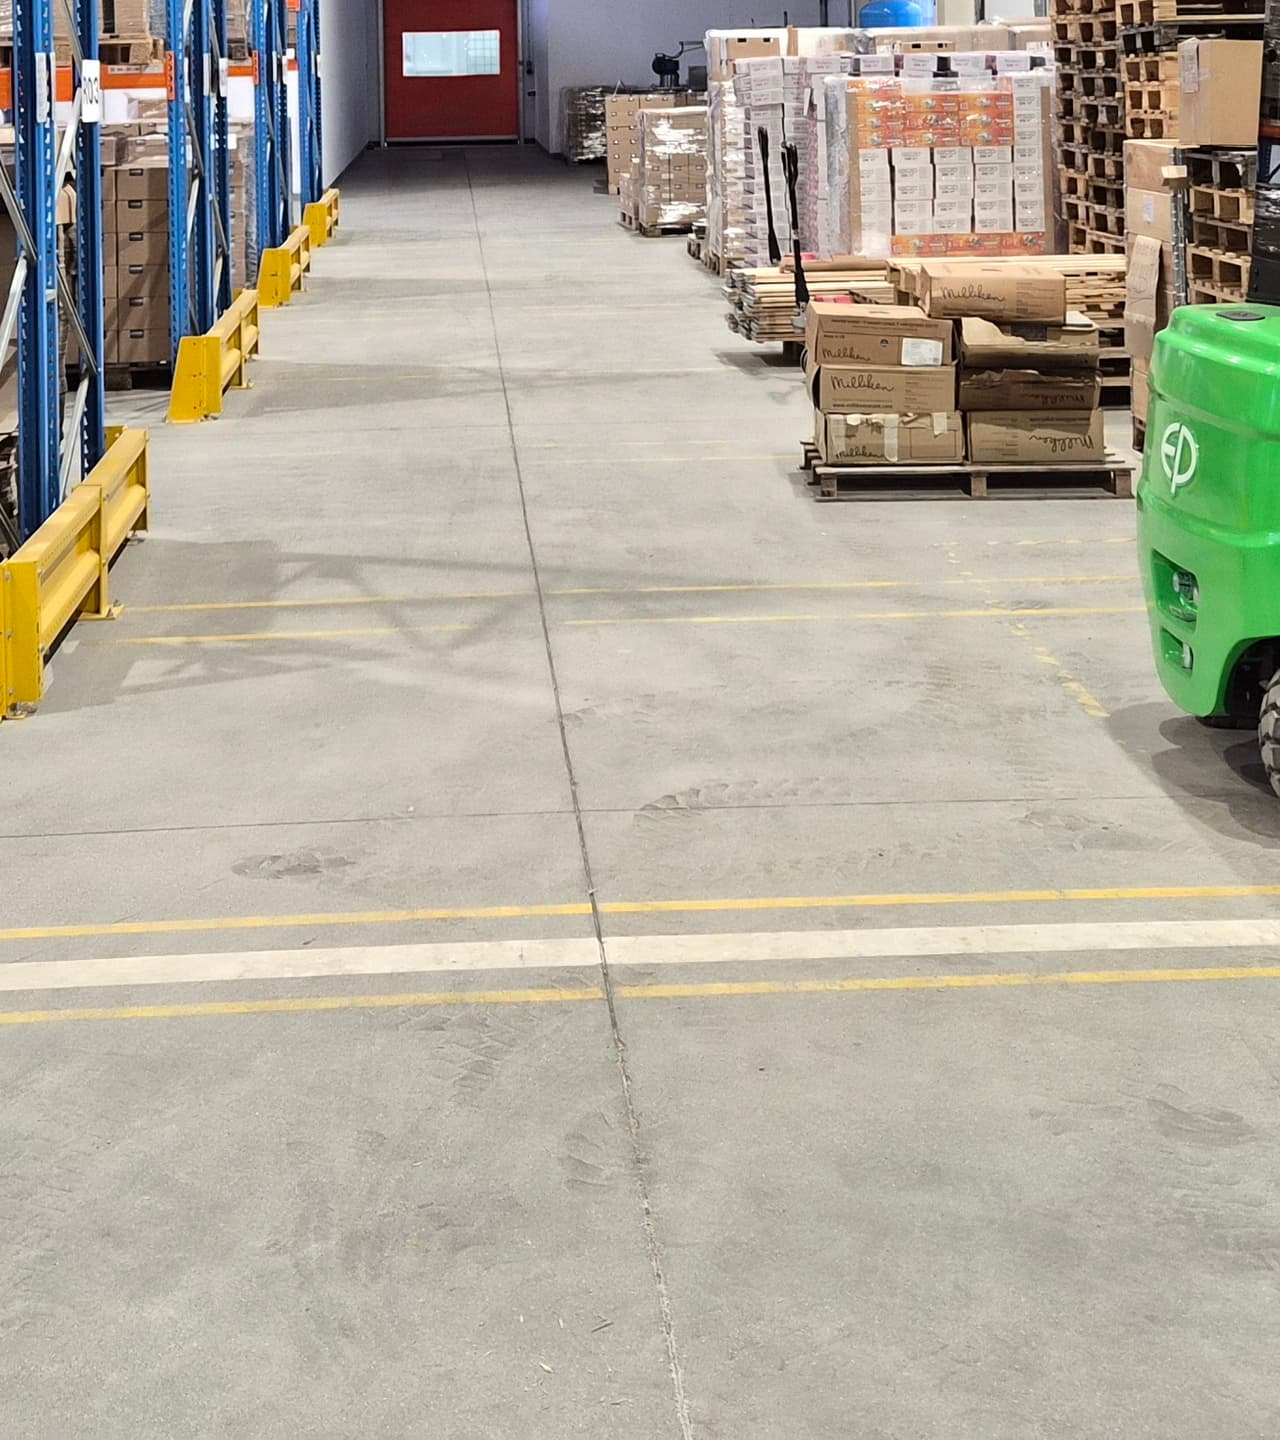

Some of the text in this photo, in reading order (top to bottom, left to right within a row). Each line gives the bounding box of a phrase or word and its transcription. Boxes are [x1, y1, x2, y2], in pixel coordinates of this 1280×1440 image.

[941, 284, 1006, 303] Milliken
[822, 347, 871, 361] Milliken
[830, 374, 895, 392] Milliken
[1029, 433, 1093, 452] Milliken
[1161, 422, 1197, 494] EP
